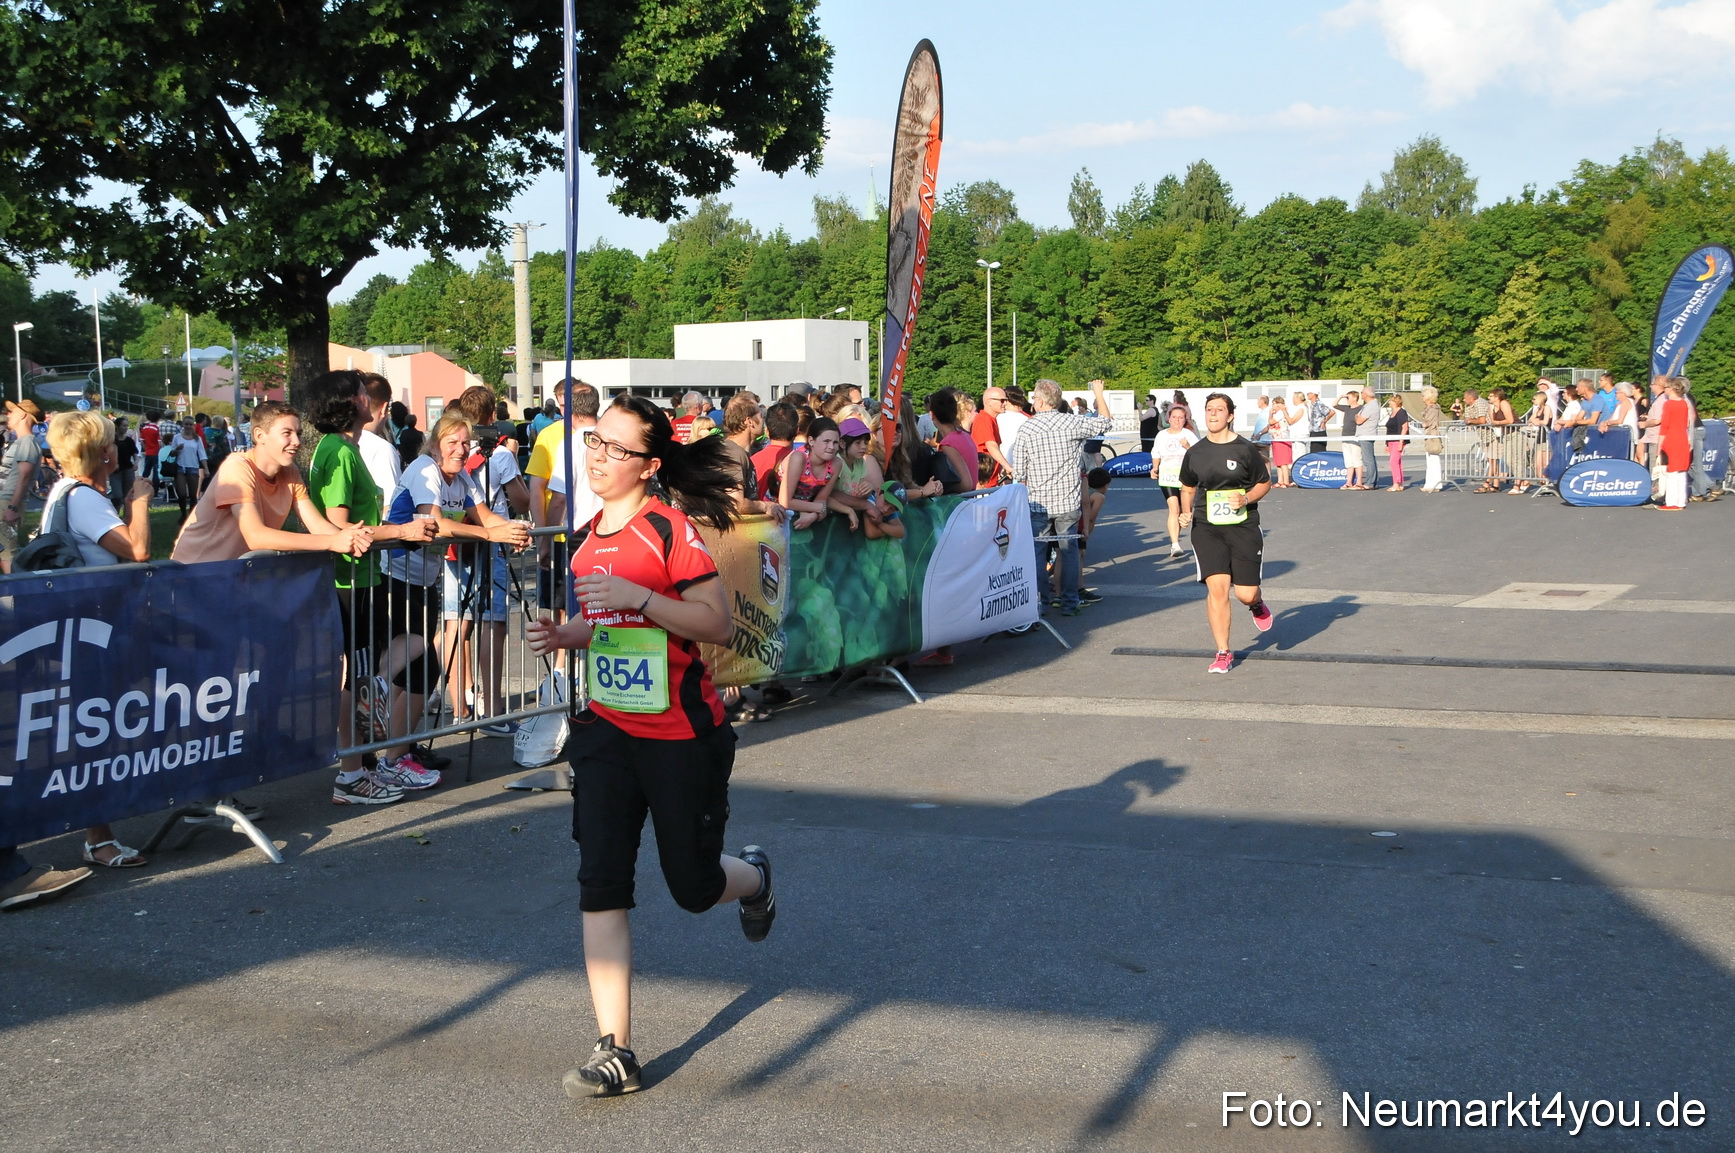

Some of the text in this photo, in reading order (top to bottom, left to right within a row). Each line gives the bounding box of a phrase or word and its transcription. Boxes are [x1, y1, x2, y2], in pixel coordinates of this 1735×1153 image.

[1656, 282, 1711, 357] Frischmann
[1117, 463, 1152, 475] Fischer
[1309, 467, 1347, 477] Fische
[1582, 479, 1642, 491] Fischer
[988, 566, 1023, 591] Neumarkter
[980, 583, 1029, 621] Lammsbräu
[596, 656, 654, 692] 854
[15, 667, 260, 762] Fischer
[41, 729, 244, 798] AUTOMOBILE
